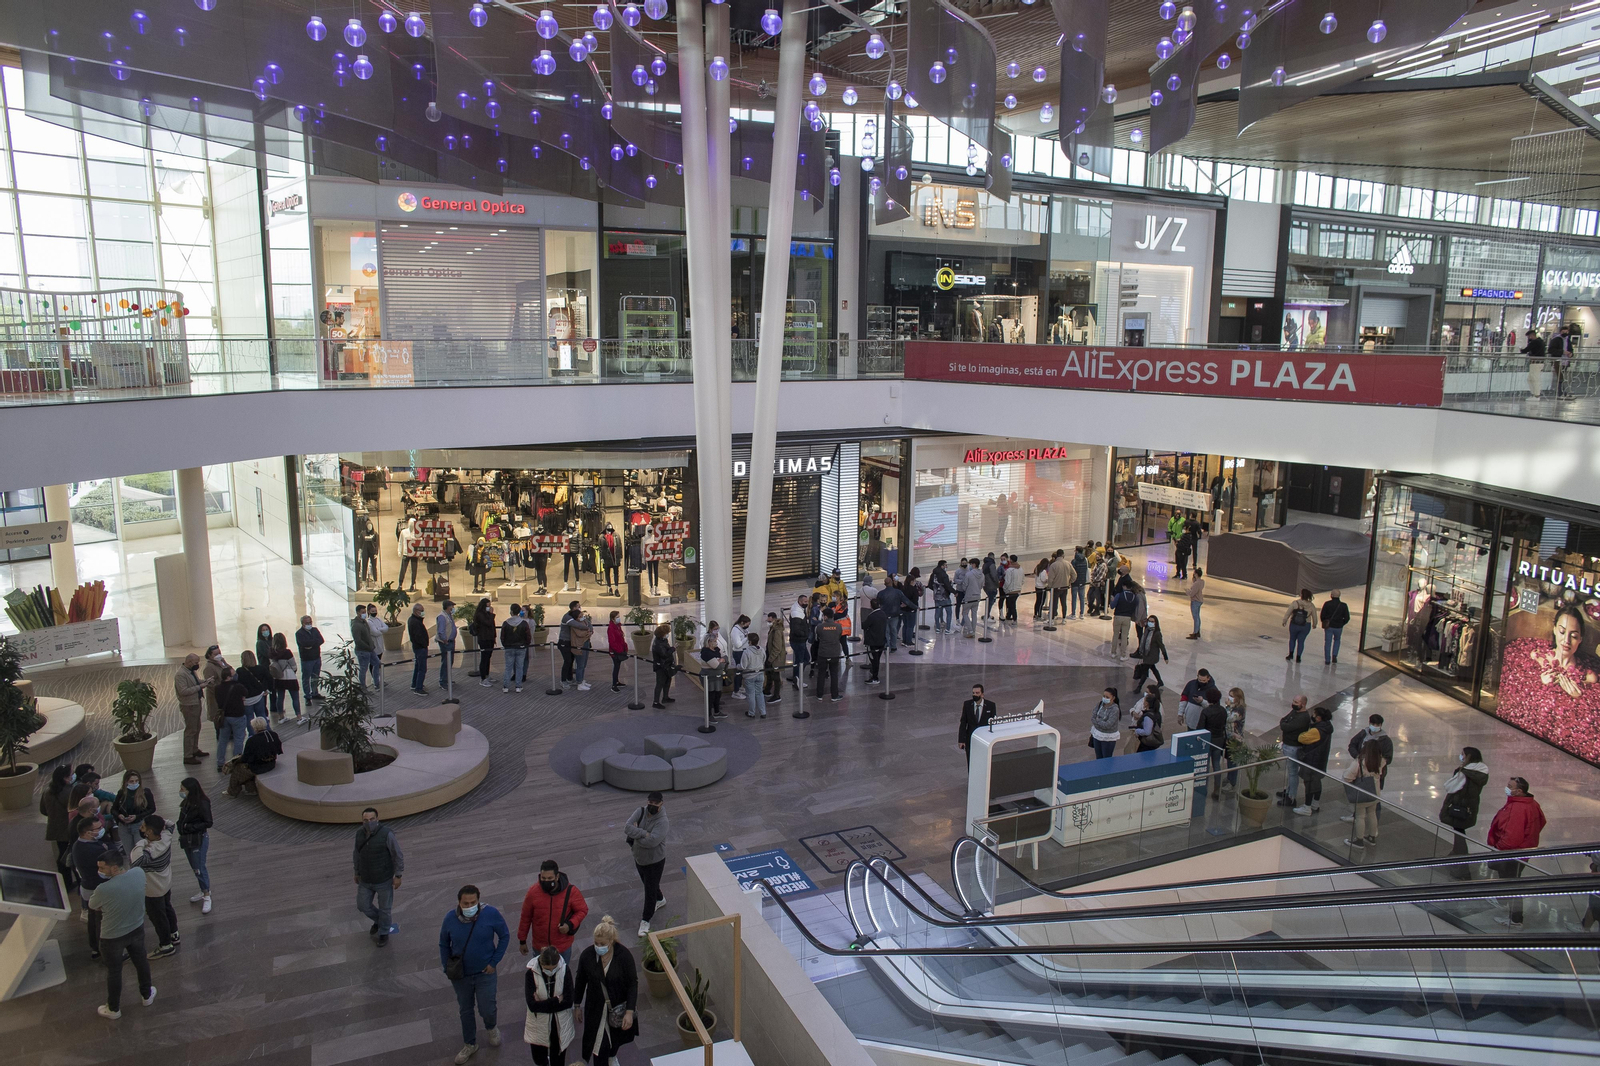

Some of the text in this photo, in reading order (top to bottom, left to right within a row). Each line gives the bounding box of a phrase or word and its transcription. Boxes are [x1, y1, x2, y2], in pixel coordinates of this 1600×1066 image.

[421, 196, 526, 215] General Optica
[924, 197, 976, 229] INS
[1135, 215, 1188, 252] JVZ
[1388, 264, 1414, 275] adidas
[1472, 289, 1515, 299] SPAGNOLO
[949, 348, 1357, 392] Si te lo imaginas, está en AliExpress PLAZA
[964, 447, 1068, 466] AliExpress PLAZA
[414, 520, 451, 538] SALE
[868, 512, 897, 529] SALE
[654, 521, 690, 540] SALE
[407, 539, 444, 557] SALE
[532, 535, 569, 553] SALE
[645, 541, 682, 561] SALE
[1519, 560, 1600, 598] RITUALS
